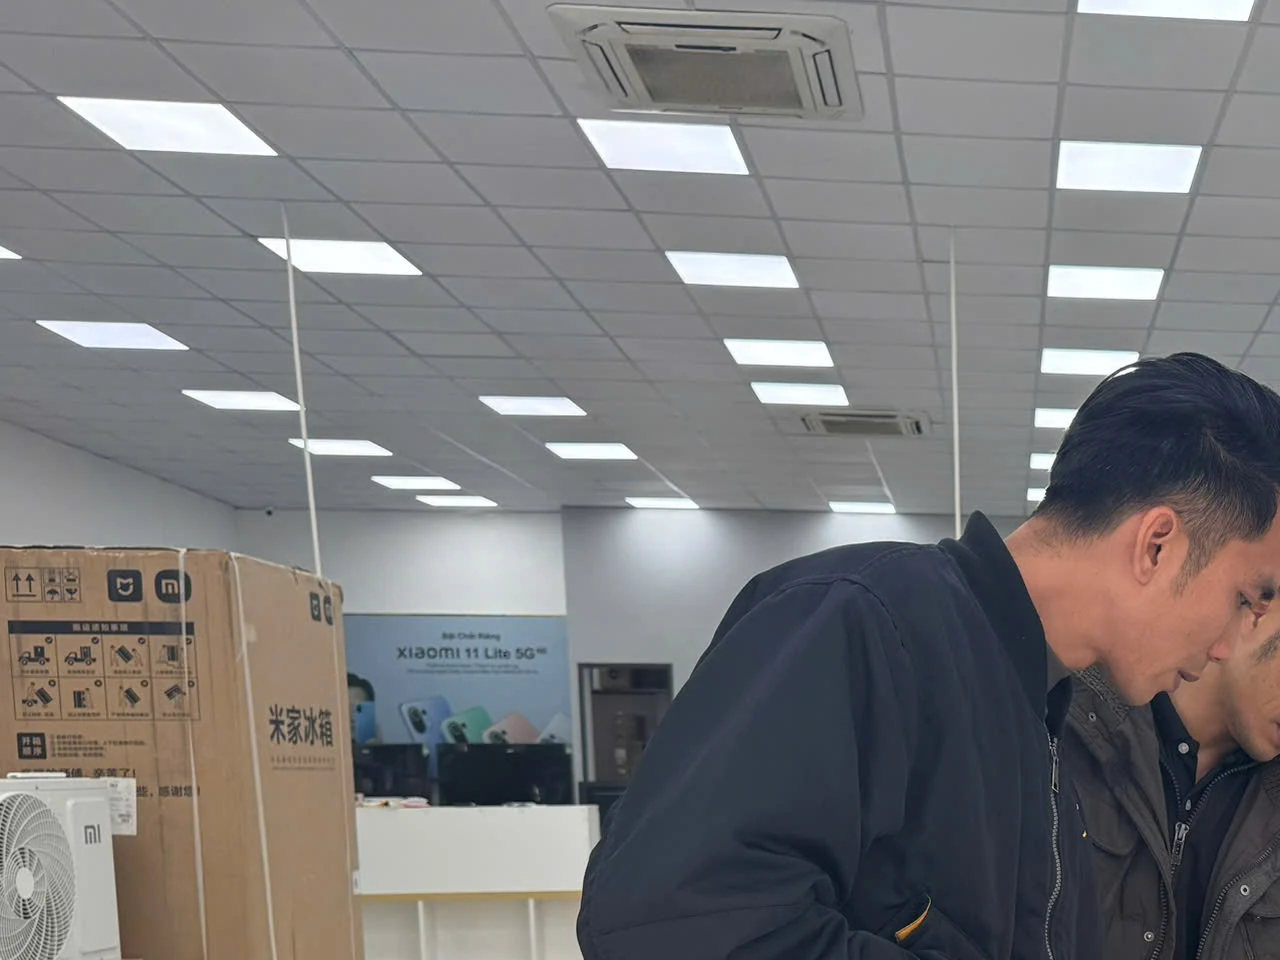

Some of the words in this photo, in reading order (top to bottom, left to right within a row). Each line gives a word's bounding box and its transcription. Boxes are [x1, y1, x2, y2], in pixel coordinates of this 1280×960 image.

[465, 648, 480, 660] 11
[485, 647, 512, 660] Lite
[515, 648, 536, 660] 5G
[268, 705, 334, 748] 米家冰箱
